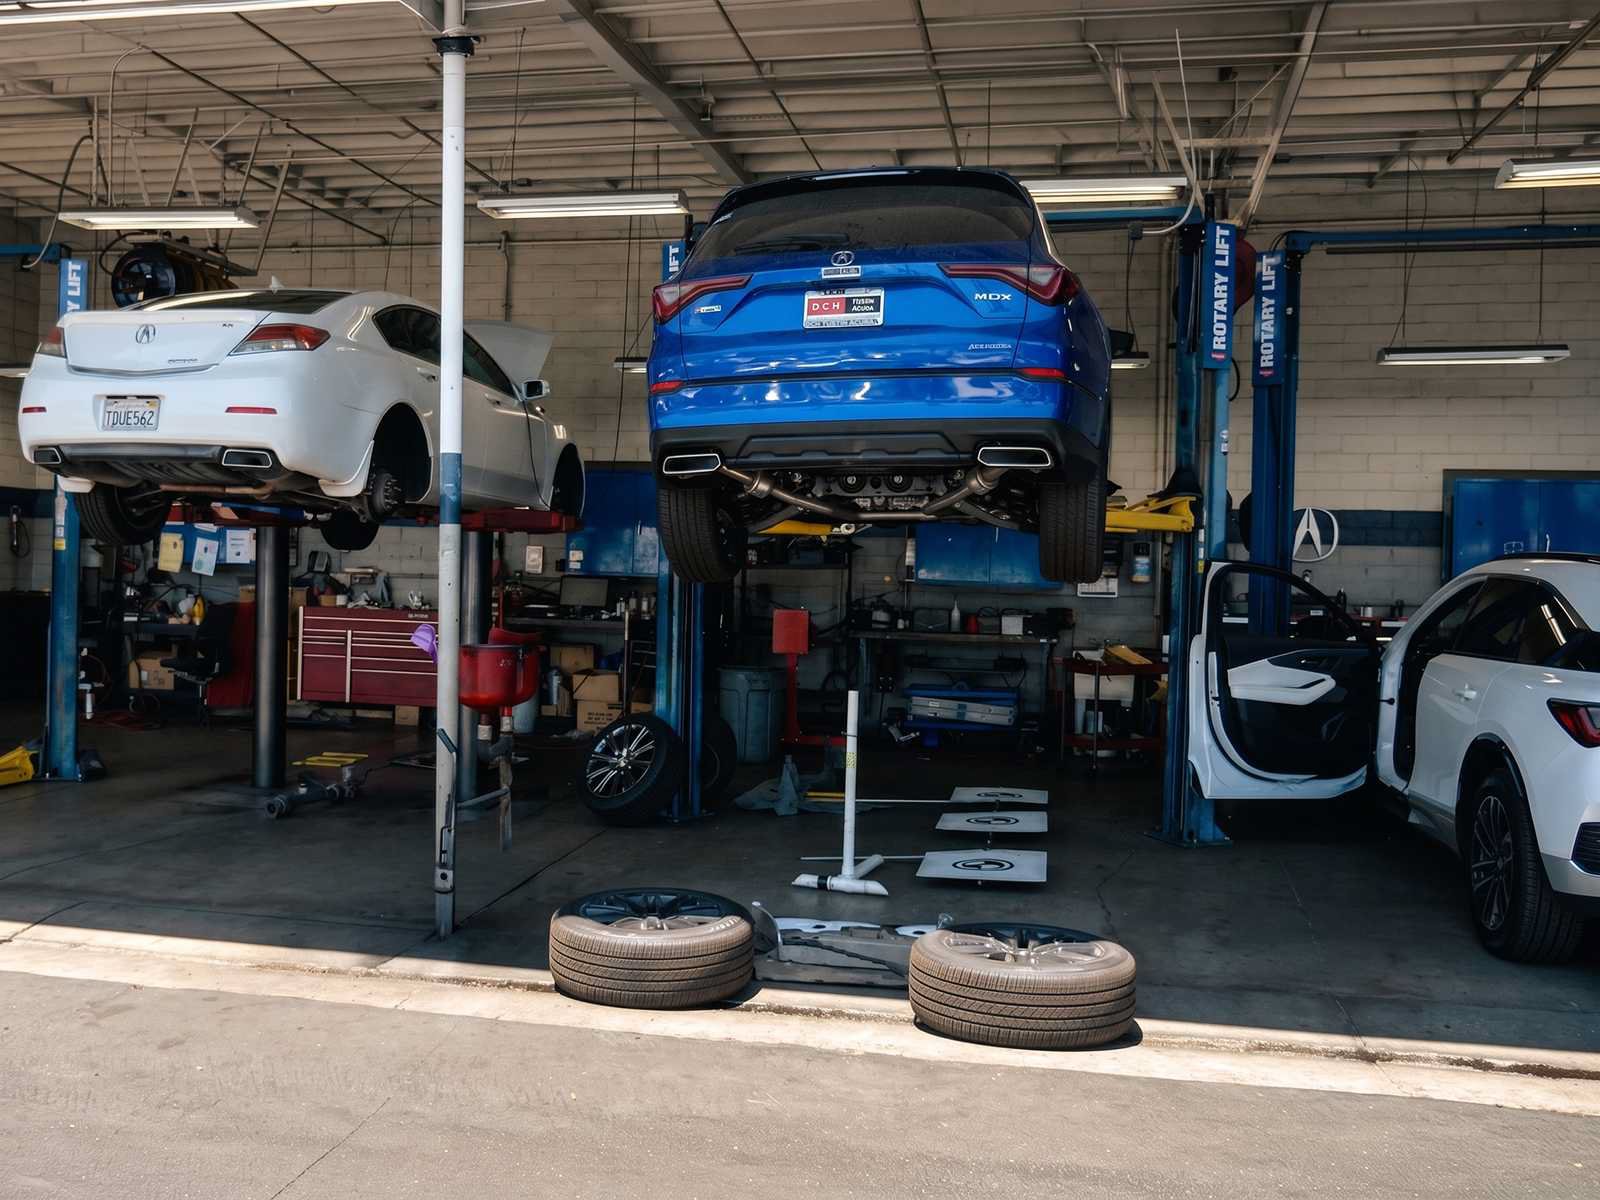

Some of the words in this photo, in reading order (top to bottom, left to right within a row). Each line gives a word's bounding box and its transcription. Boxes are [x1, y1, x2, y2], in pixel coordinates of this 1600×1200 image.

[669, 245, 679, 272] IFT
[1215, 226, 1229, 266] LIFT
[68, 261, 81, 296] LIFT
[1262, 255, 1280, 291] LIFT
[975, 293, 1012, 301] MDX
[1213, 273, 1228, 350] ROTARY
[1260, 297, 1275, 367] ROTARY
